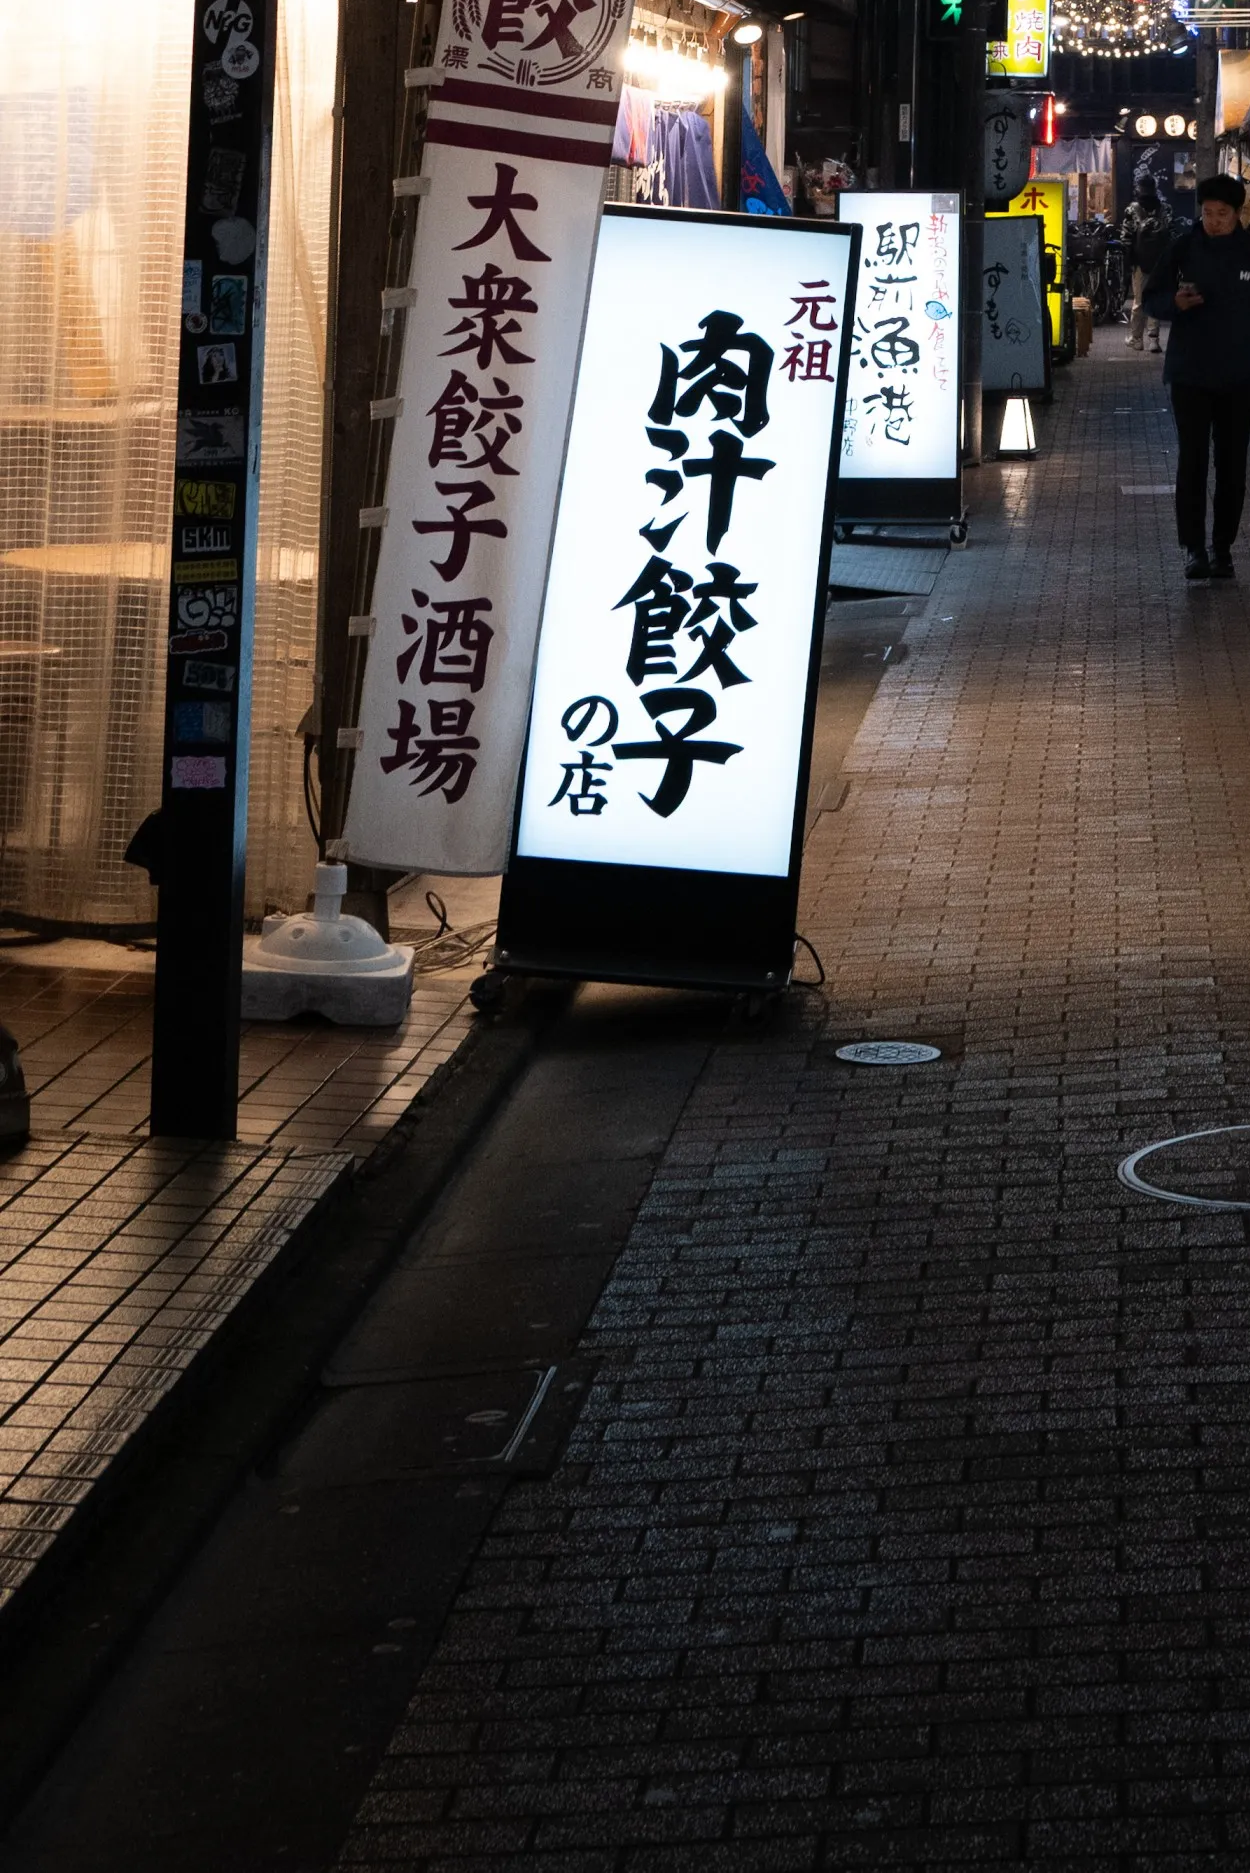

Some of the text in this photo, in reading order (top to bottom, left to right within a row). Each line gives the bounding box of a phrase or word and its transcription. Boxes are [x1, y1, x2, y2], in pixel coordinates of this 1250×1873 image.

[1015, 9, 1045, 62] 焼肉
[778, 279, 839, 384] 元祖
[850, 221, 921, 447] 駅前漁港
[380, 162, 552, 807] 大衆餃子酒場
[611, 309, 777, 820] 肉汁餃子
[547, 693, 620, 818] の店
